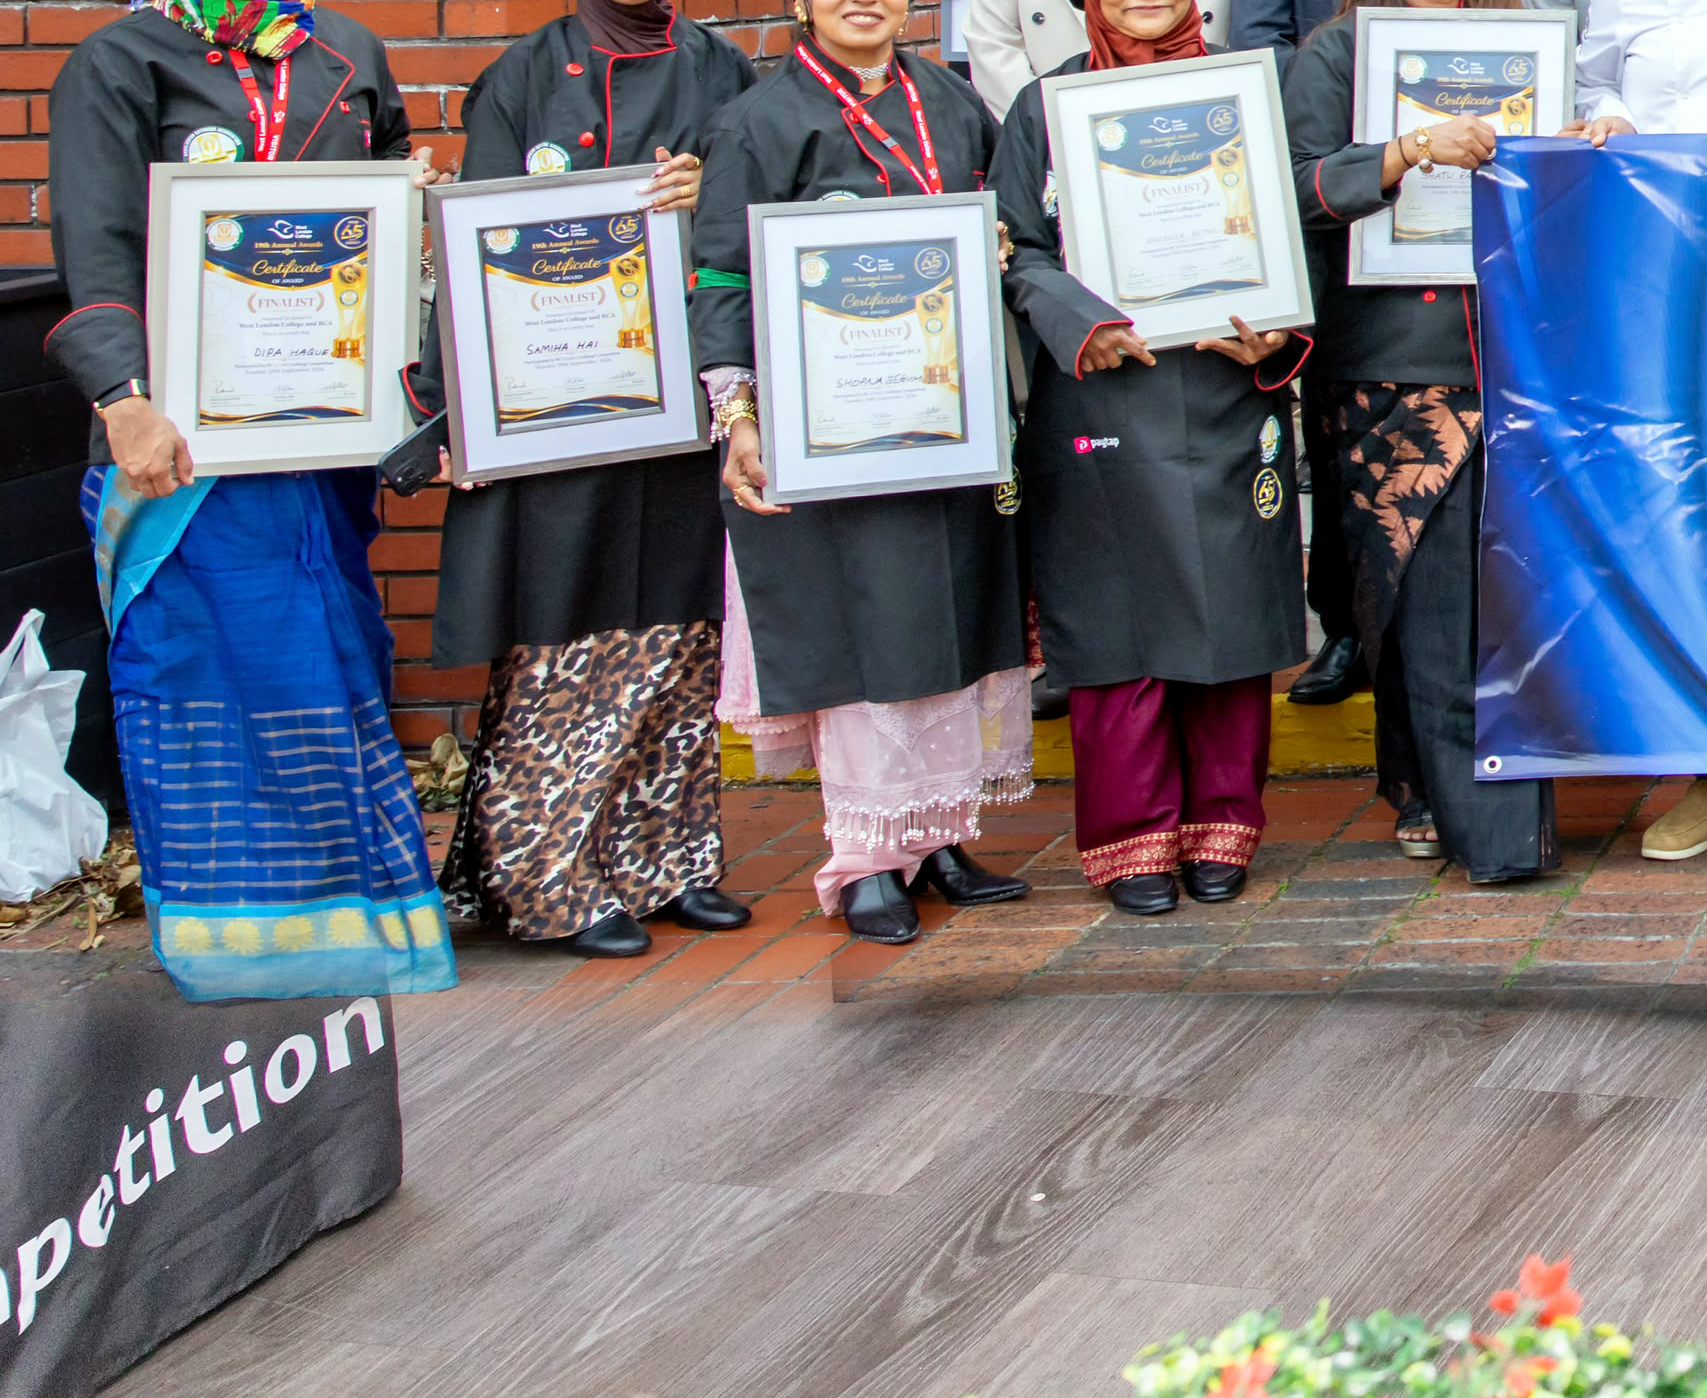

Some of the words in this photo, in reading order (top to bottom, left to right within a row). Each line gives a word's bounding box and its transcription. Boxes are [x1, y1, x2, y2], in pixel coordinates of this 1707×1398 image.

[252, 259, 325, 279] Certificate
[531, 256, 602, 276] Certificate
[258, 296, 317, 309] FINALIST
[540, 291, 598, 307] FINALIST
[841, 291, 908, 310] Certificate
[848, 326, 905, 341] FINALIST
[0, 995, 387, 1336] petition
